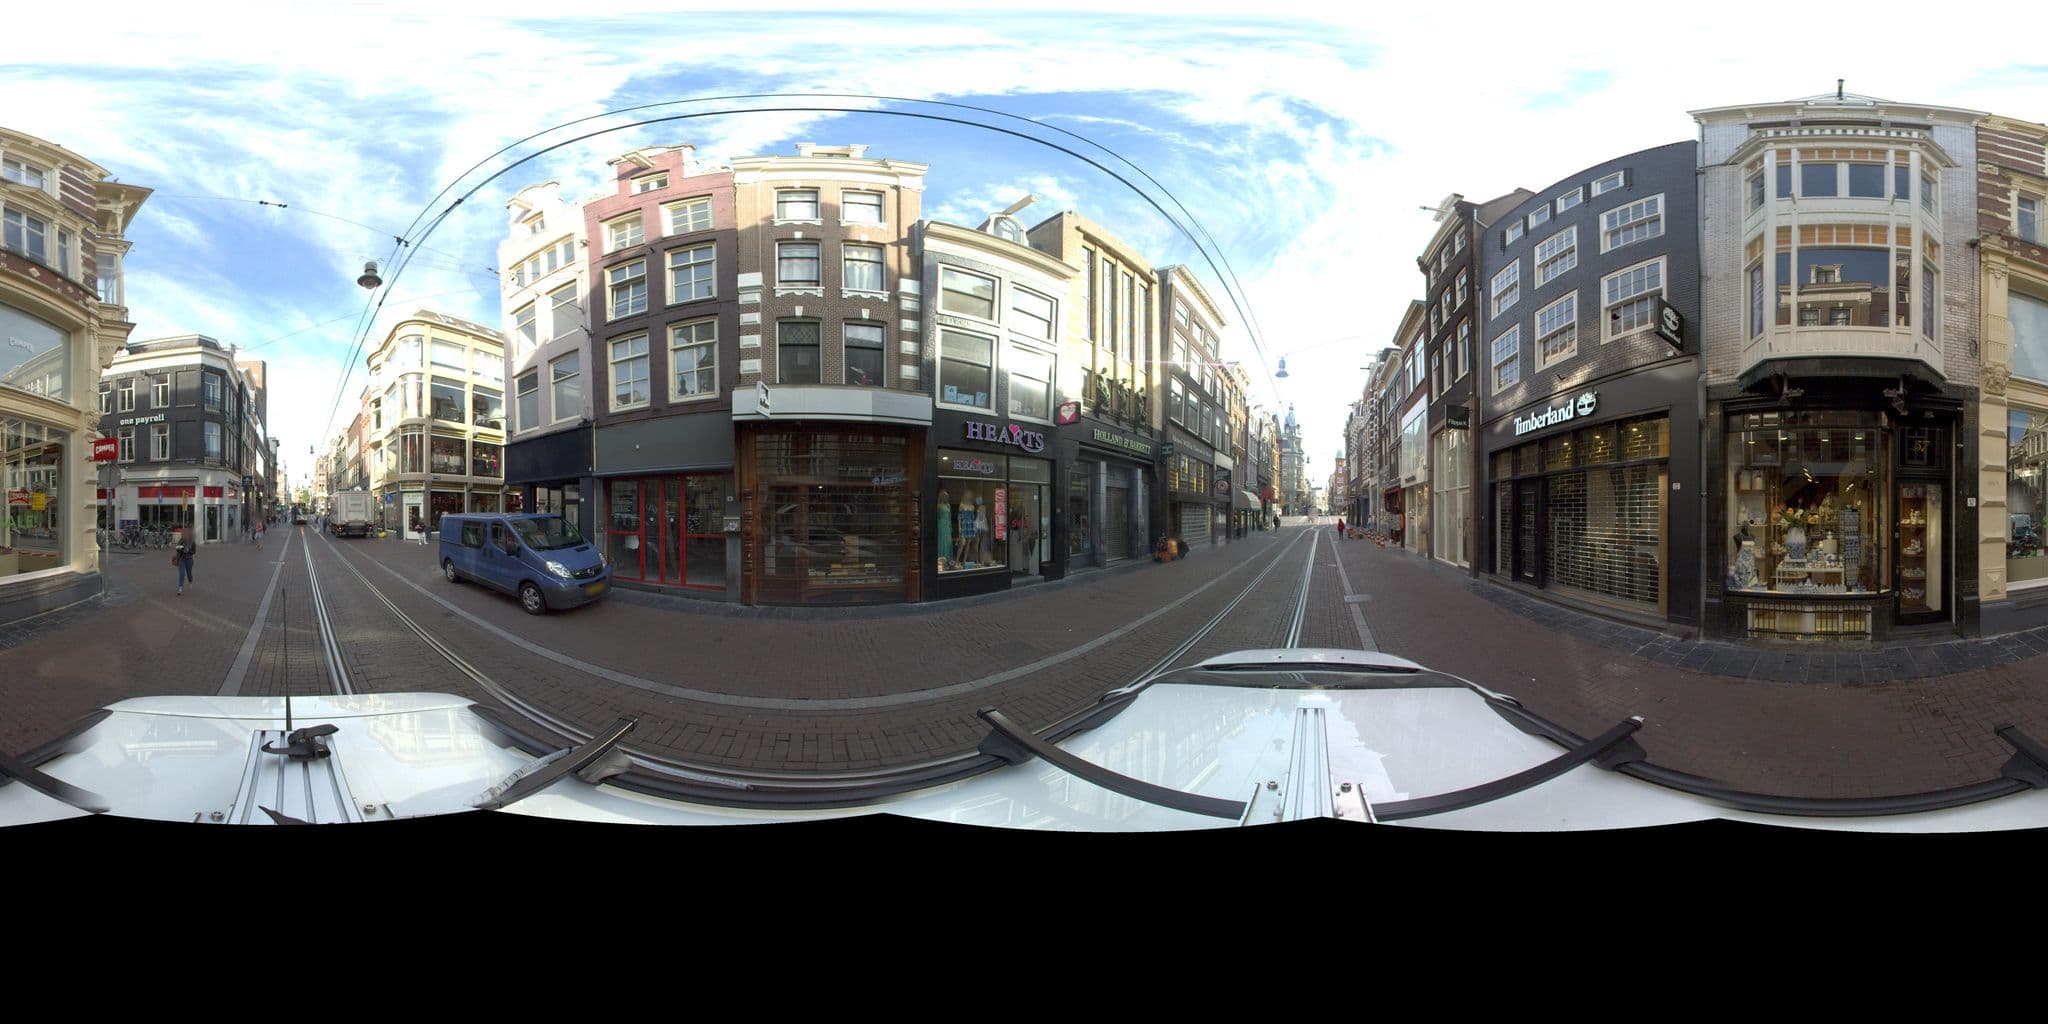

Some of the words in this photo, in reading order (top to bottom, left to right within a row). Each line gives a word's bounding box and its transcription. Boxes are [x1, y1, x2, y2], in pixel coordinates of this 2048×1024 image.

[120, 418, 134, 426] one
[135, 413, 165, 426] payroll
[1514, 397, 1575, 436] Timberland
[95, 443, 115, 455] CAMPER
[966, 421, 1045, 453] HEARTS
[1093, 428, 1123, 447] HOLLAND
[1129, 440, 1152, 455] BARRETT
[994, 488, 1008, 541] SALE
